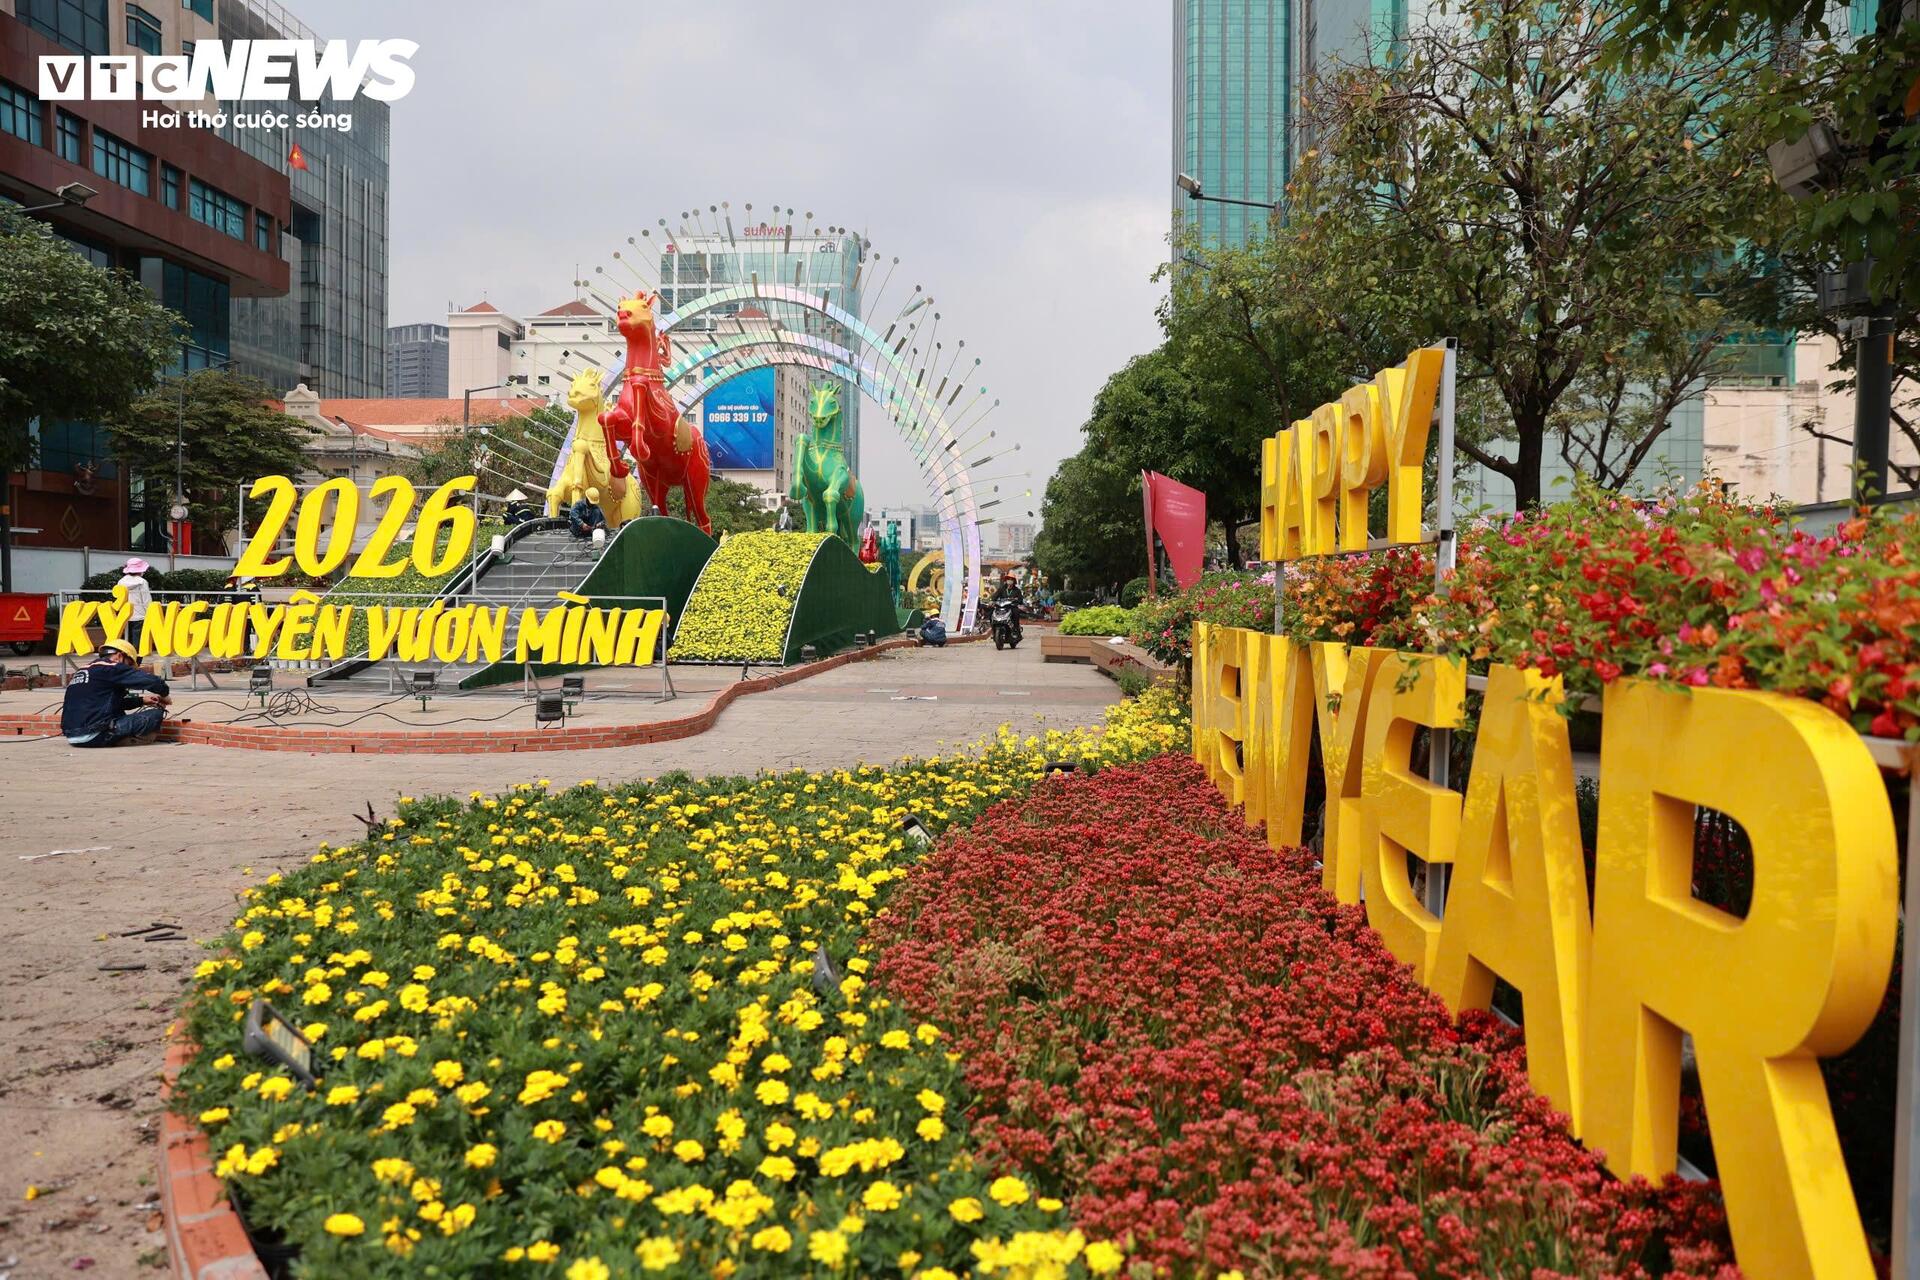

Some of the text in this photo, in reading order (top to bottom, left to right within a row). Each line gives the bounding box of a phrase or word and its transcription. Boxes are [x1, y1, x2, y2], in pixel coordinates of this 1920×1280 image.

[743, 226, 792, 237] SUNWA
[709, 412, 768, 423] 0966 339 197
[1260, 348, 1446, 562] HAPPY
[232, 475, 478, 578] 2026
[138, 589, 354, 661] NGUYÊN
[515, 591, 667, 667] MÌNH
[1192, 621, 1898, 1280] NEW YEAR
